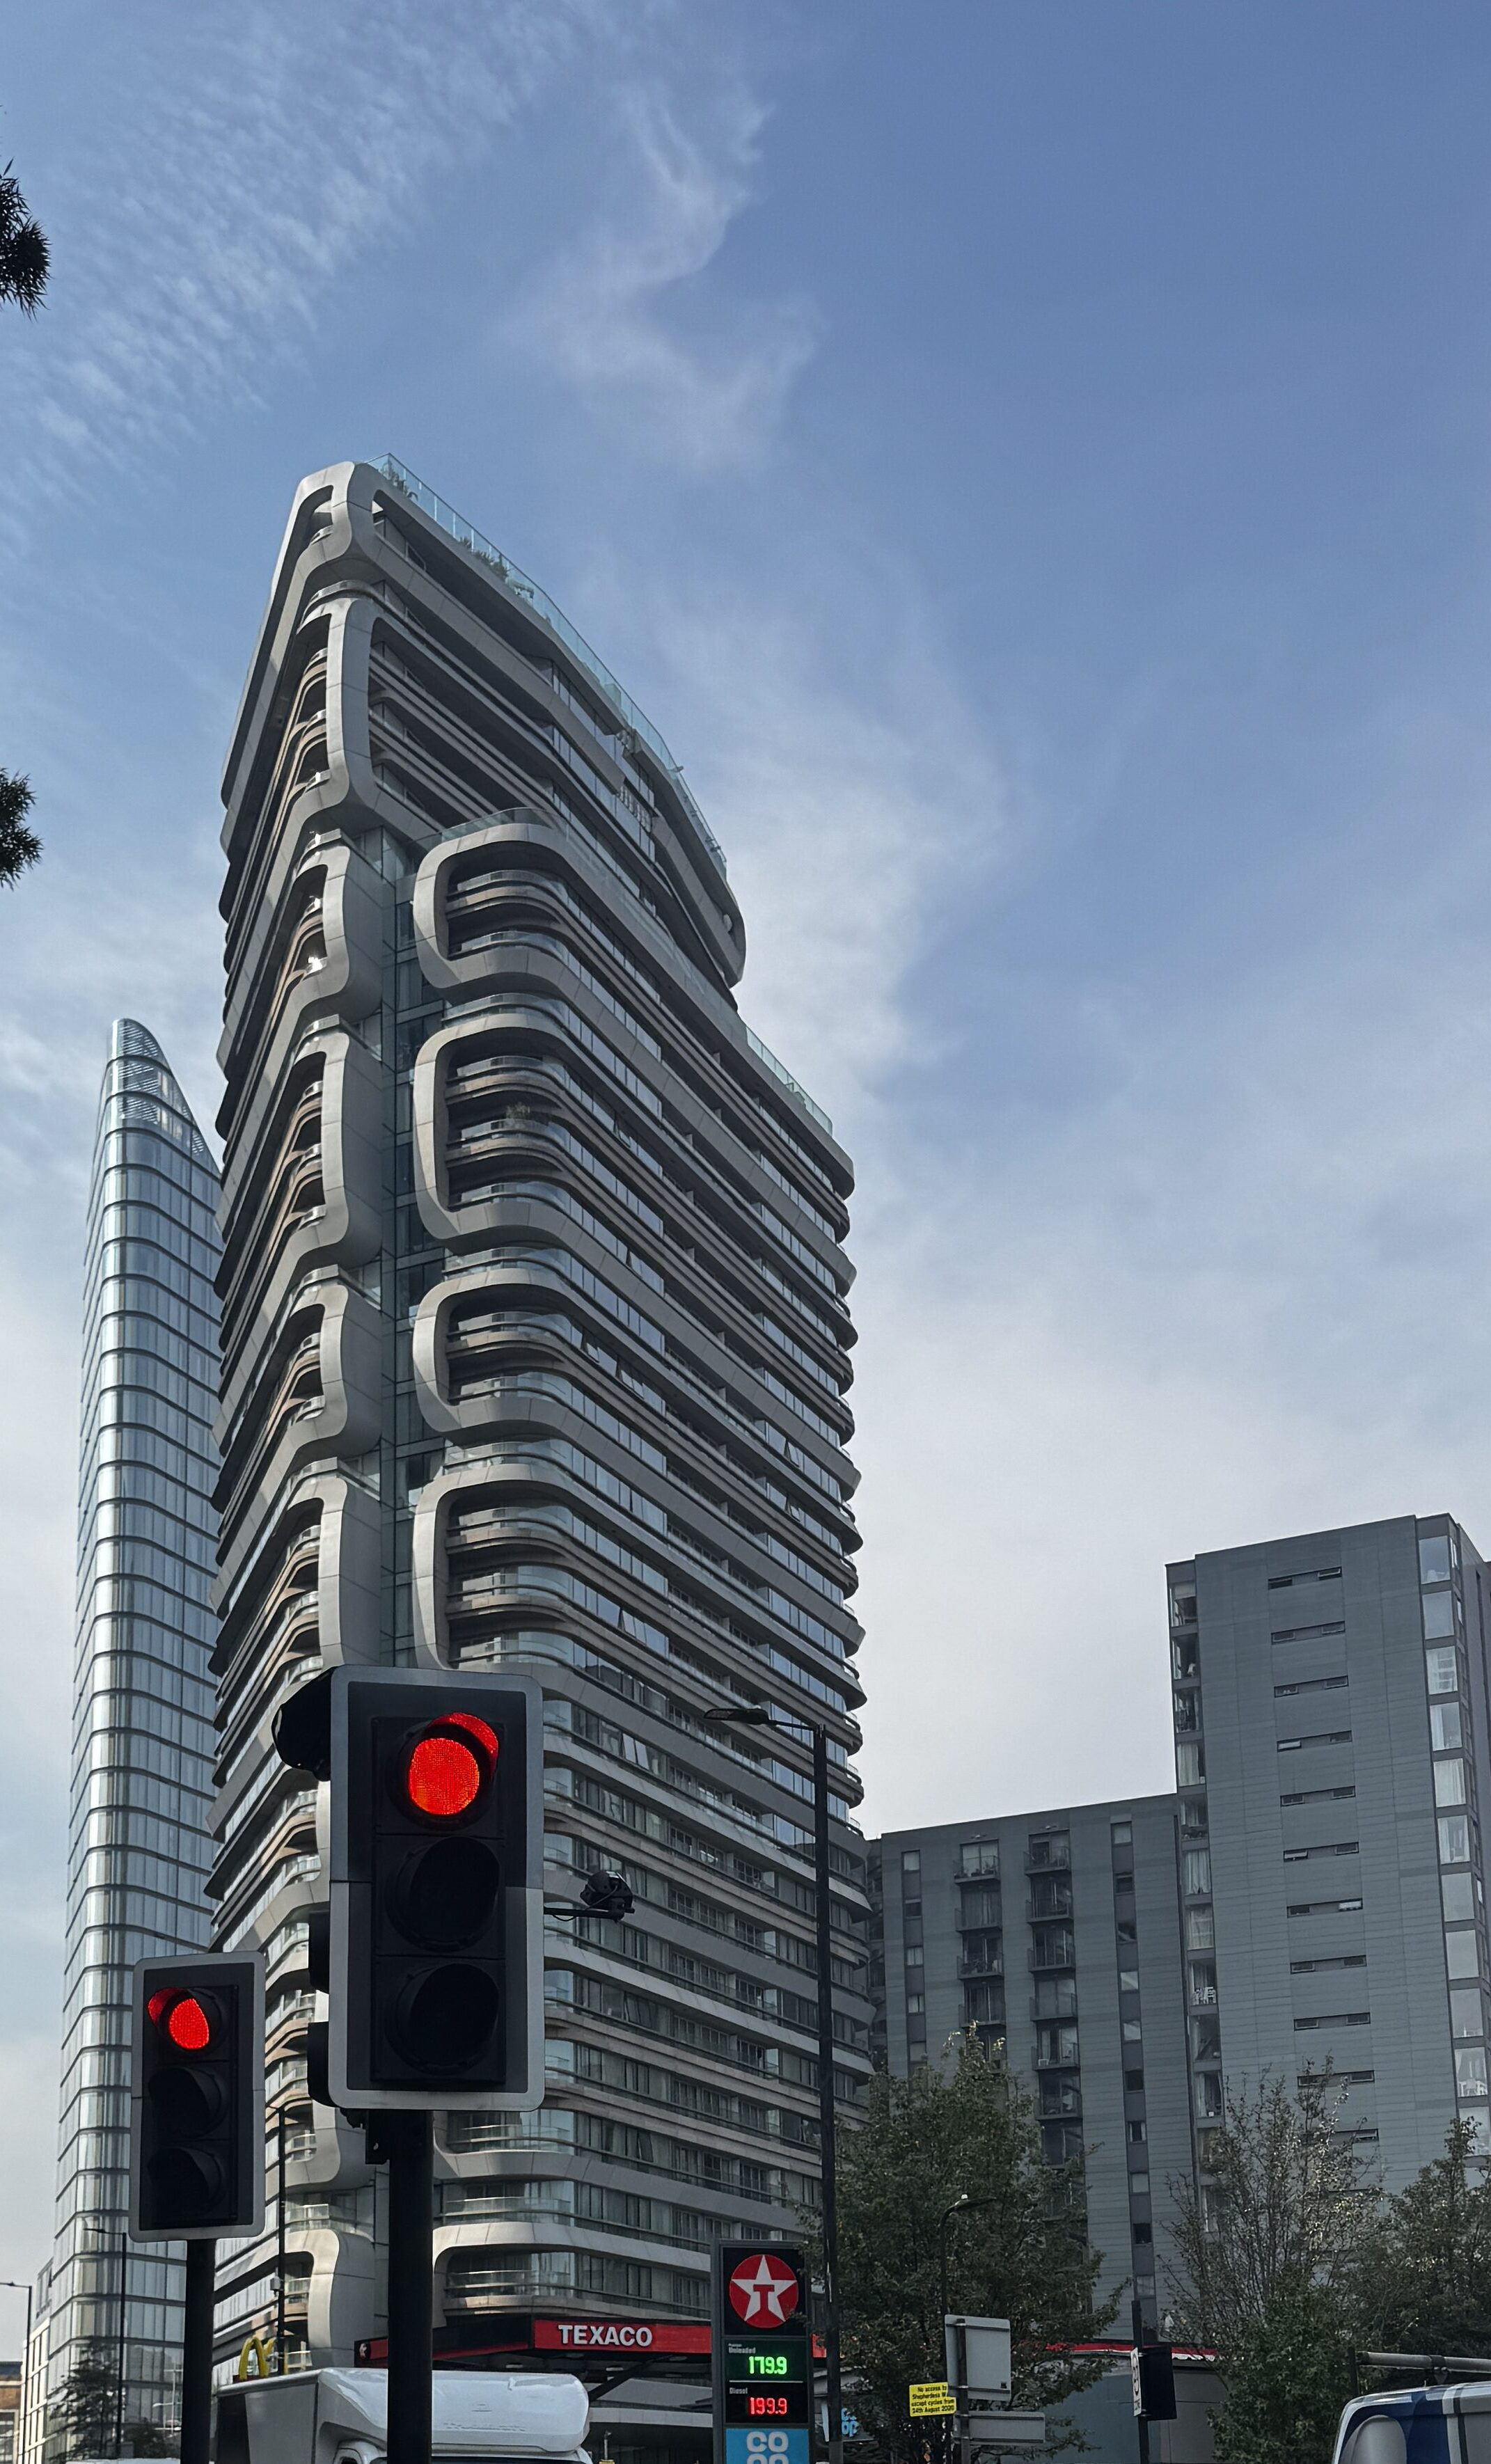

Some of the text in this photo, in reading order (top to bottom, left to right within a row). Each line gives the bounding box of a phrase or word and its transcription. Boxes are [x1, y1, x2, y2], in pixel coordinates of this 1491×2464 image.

[558, 2325, 652, 2346] TEXACO
[748, 2356, 787, 2374] 179.9
[750, 2397, 787, 2415] 199.9
